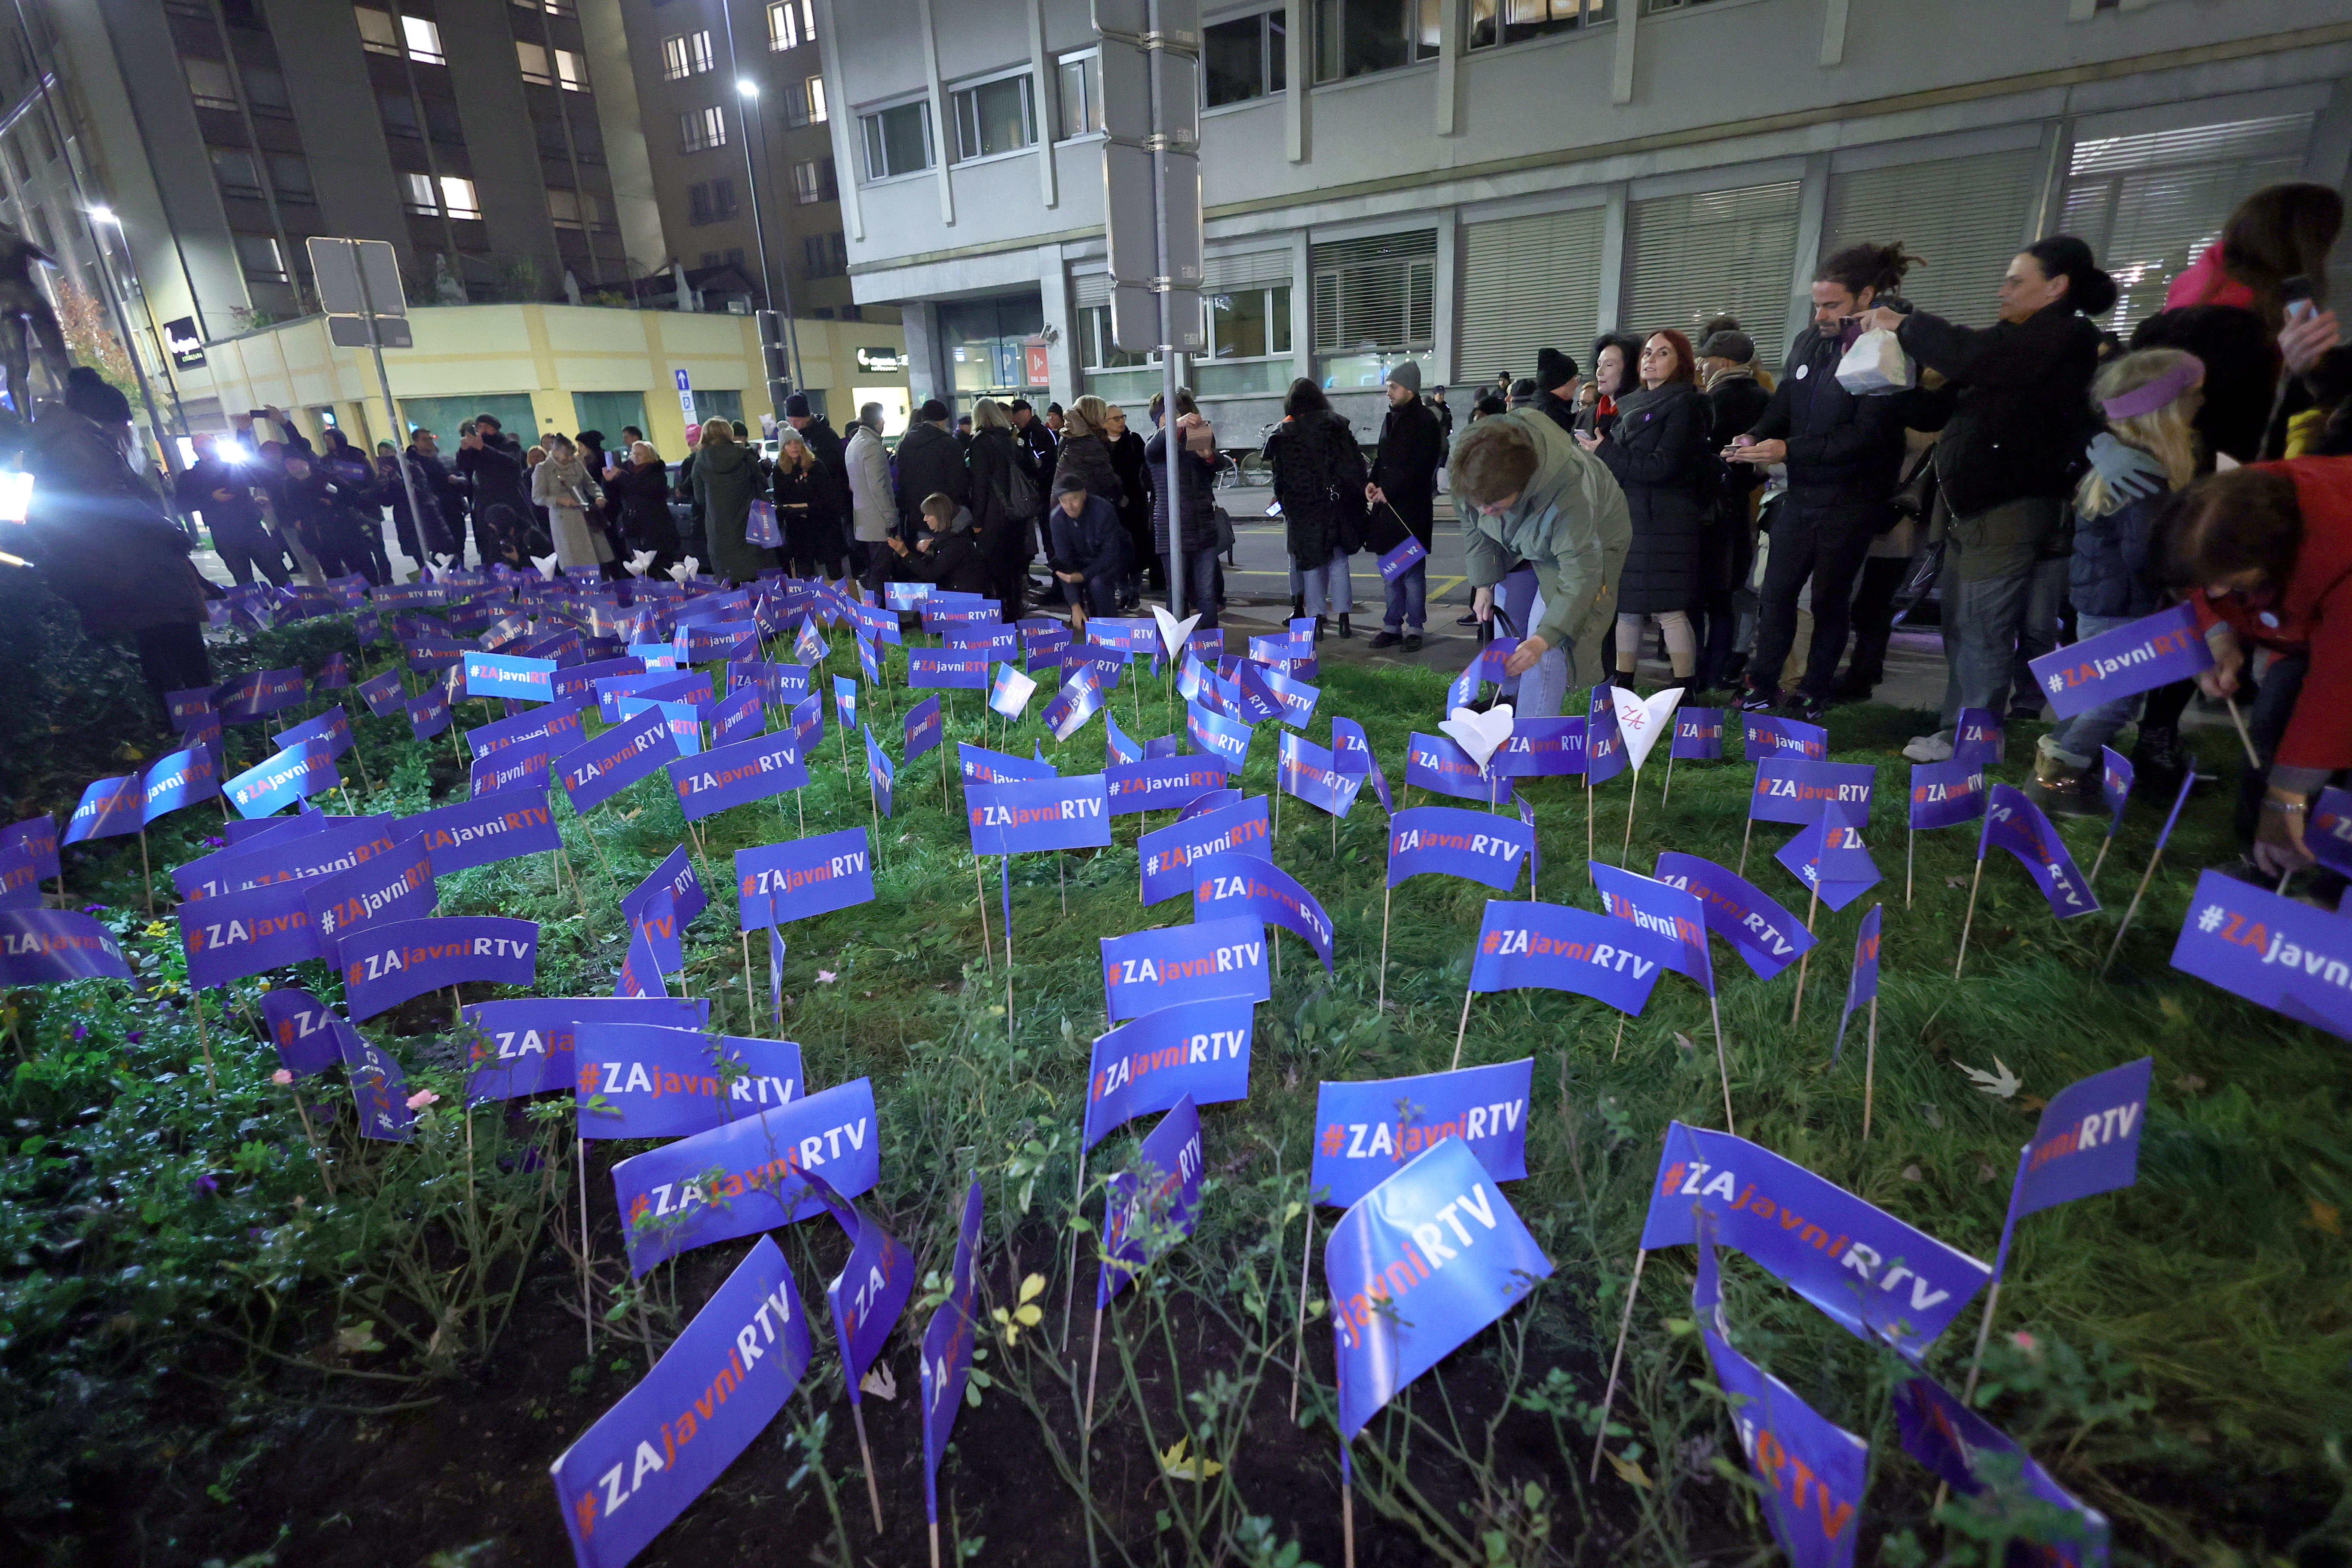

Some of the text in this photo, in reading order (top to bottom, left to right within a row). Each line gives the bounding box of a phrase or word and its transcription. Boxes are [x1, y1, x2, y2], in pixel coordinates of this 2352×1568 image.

[470, 665, 547, 683] #ZAjavniRT
[645, 656, 675, 667] javniRTV
[912, 660, 989, 674] #ZAjavniRTV
[1621, 706, 1645, 730] ZA
[236, 751, 331, 805] #ZAjavniRTV
[474, 752, 548, 796] #ZAjavniRTV
[565, 722, 665, 792] #ZAjavniRTV
[677, 747, 795, 797] #ZAjavniRTV
[1109, 771, 1225, 797] #ZAjavniRTV
[1758, 777, 1870, 804] #ZAjavniRTV
[971, 797, 1102, 828] #ZAjavniRTV
[1147, 818, 1268, 878] #ZAjavniRTV
[1393, 829, 1520, 861] #ZAjavniRTV
[321, 854, 431, 935] #ZAjavniRTV
[1198, 875, 1329, 946] #ZAjavniRTV
[347, 937, 529, 987] #ZAjavniRTV
[1109, 942, 1261, 987] #ZAjavniRTV
[1482, 929, 1655, 981] #ZAjavniRTV
[1092, 1029, 1245, 1103] #ZAjavniRTV
[1661, 1161, 1949, 1312] #ZAjavniRTV
[1340, 1182, 1497, 1348] javniRTV
[576, 1279, 792, 1541] #ZAjavniRTV
